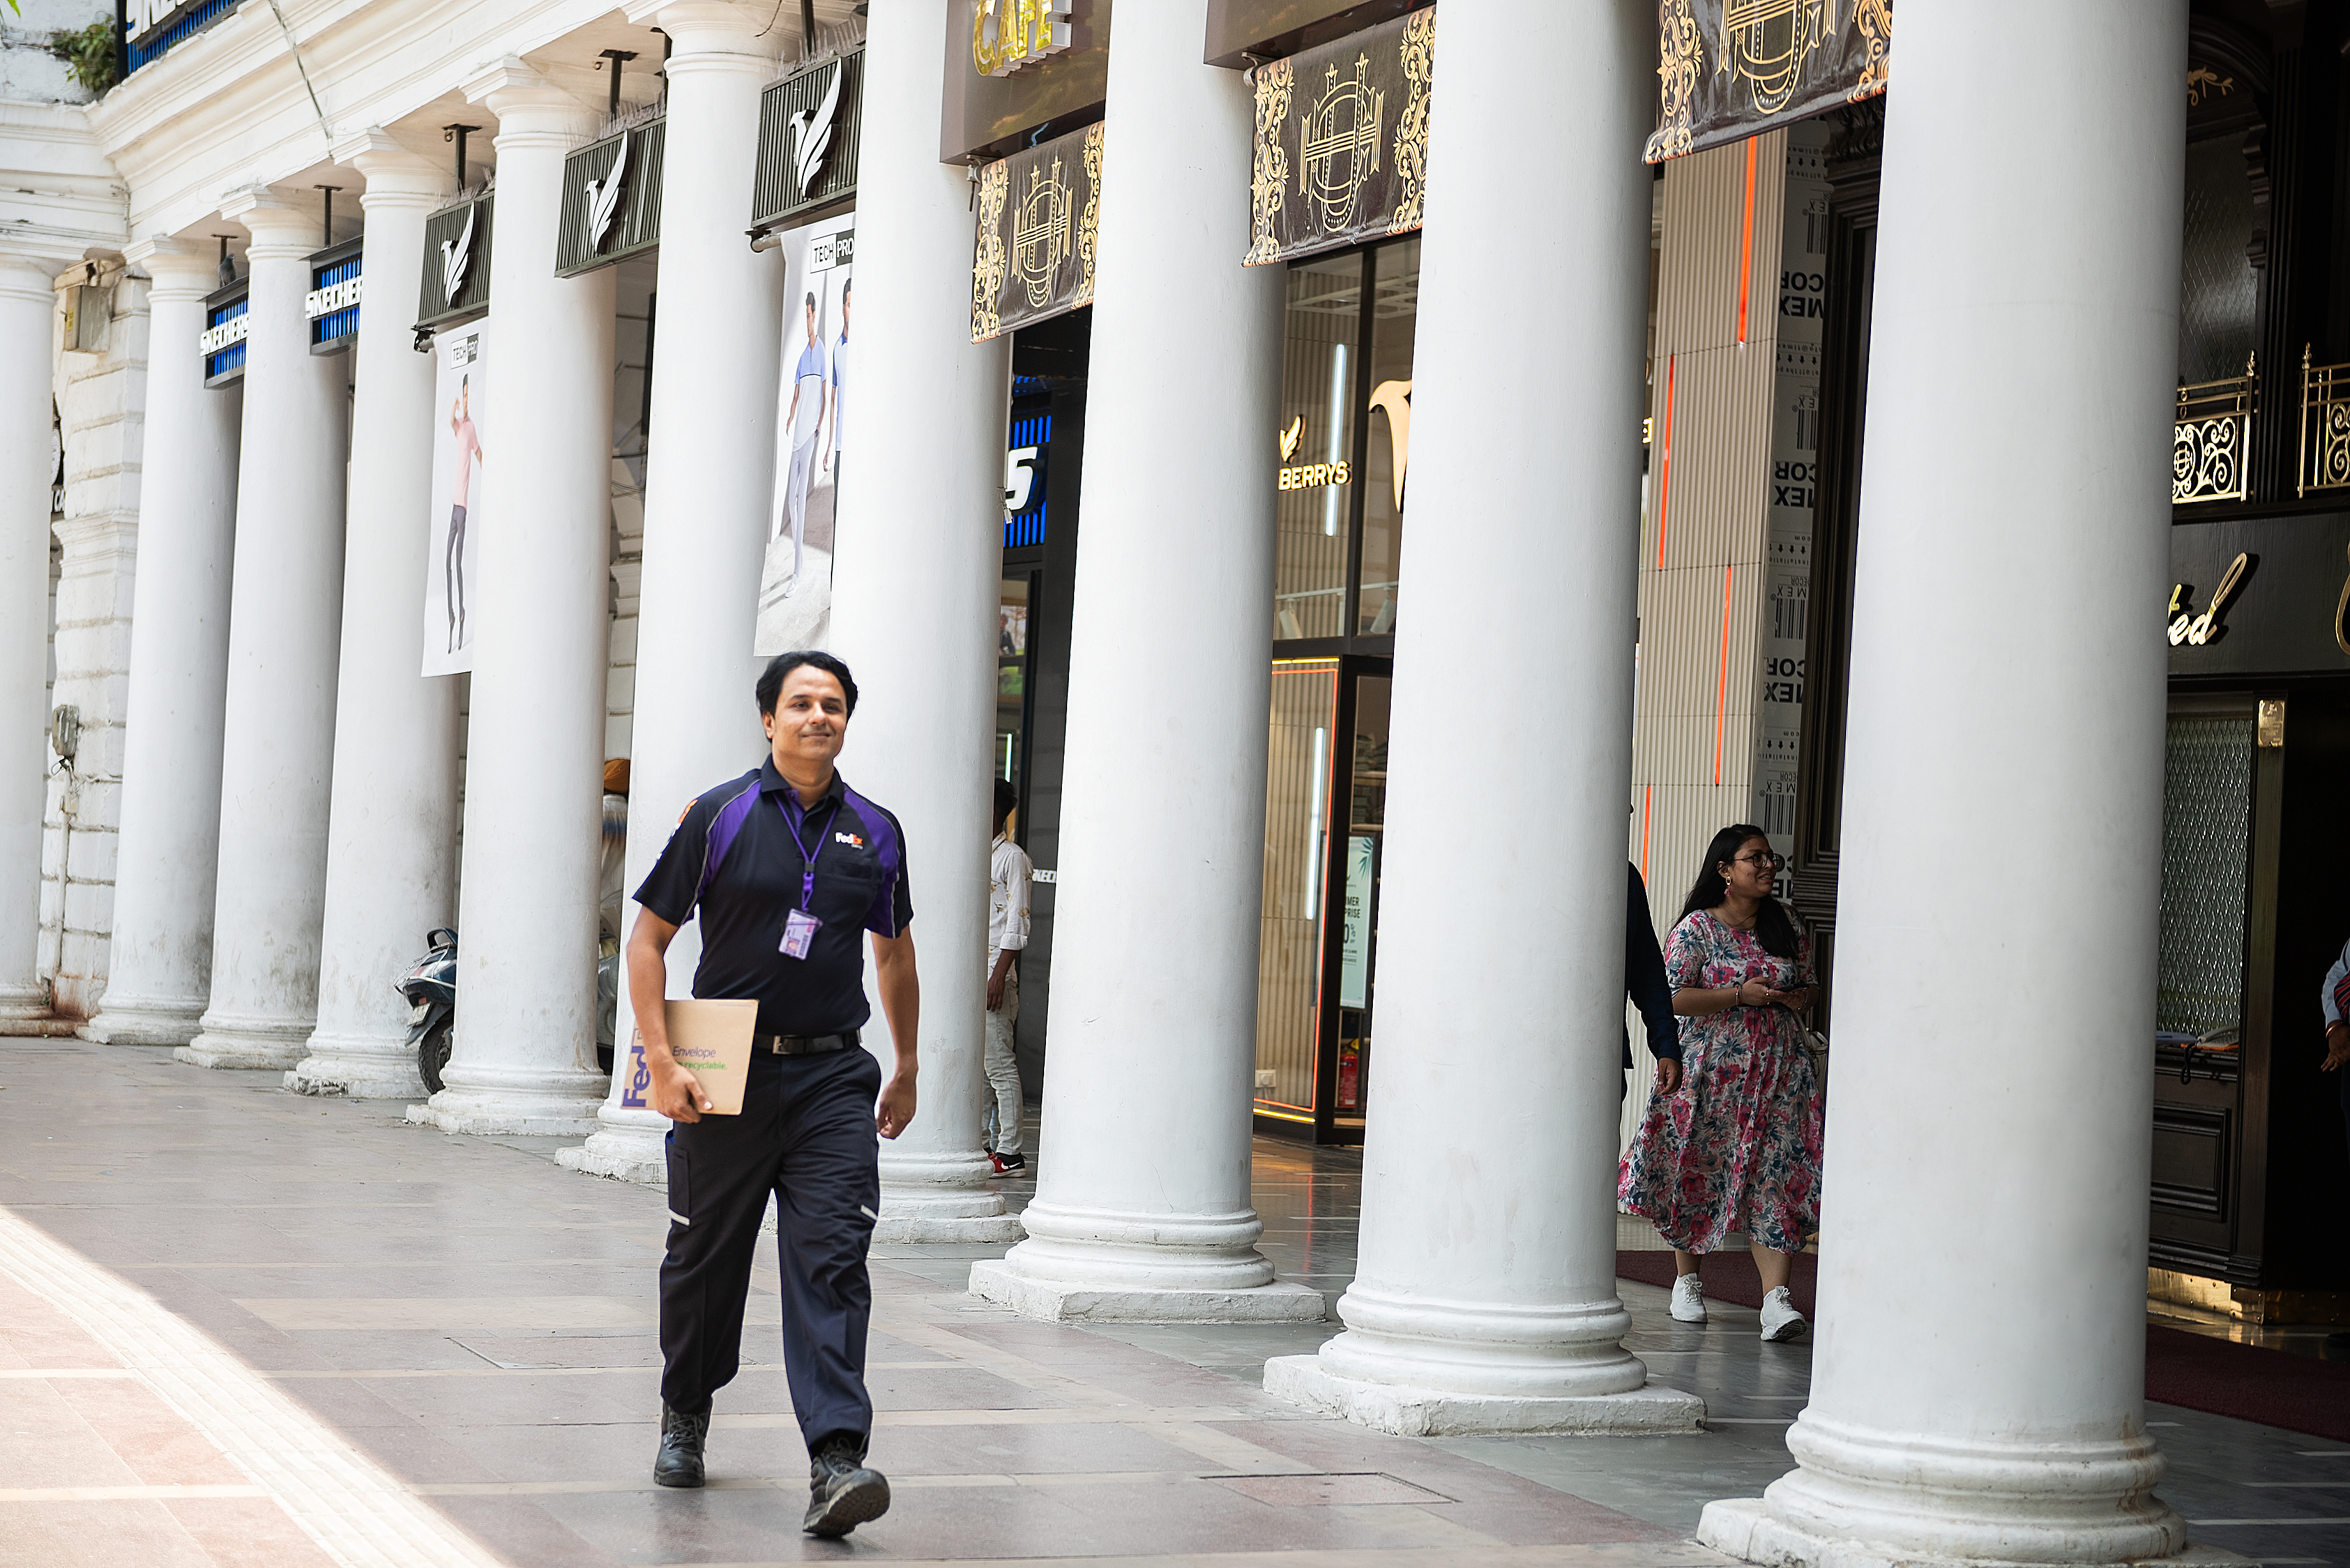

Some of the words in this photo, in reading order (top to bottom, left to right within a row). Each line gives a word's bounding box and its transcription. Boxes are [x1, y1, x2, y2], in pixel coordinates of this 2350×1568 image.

[974, 0, 1052, 76] CAFE
[814, 243, 834, 264] TECH
[837, 237, 854, 258] PRO
[453, 345, 467, 361] TECH
[467, 340, 478, 356] PRO
[1278, 460, 1348, 490] BERRYS
[835, 832, 863, 845] FedEx
[672, 1045, 716, 1060] Envelope
